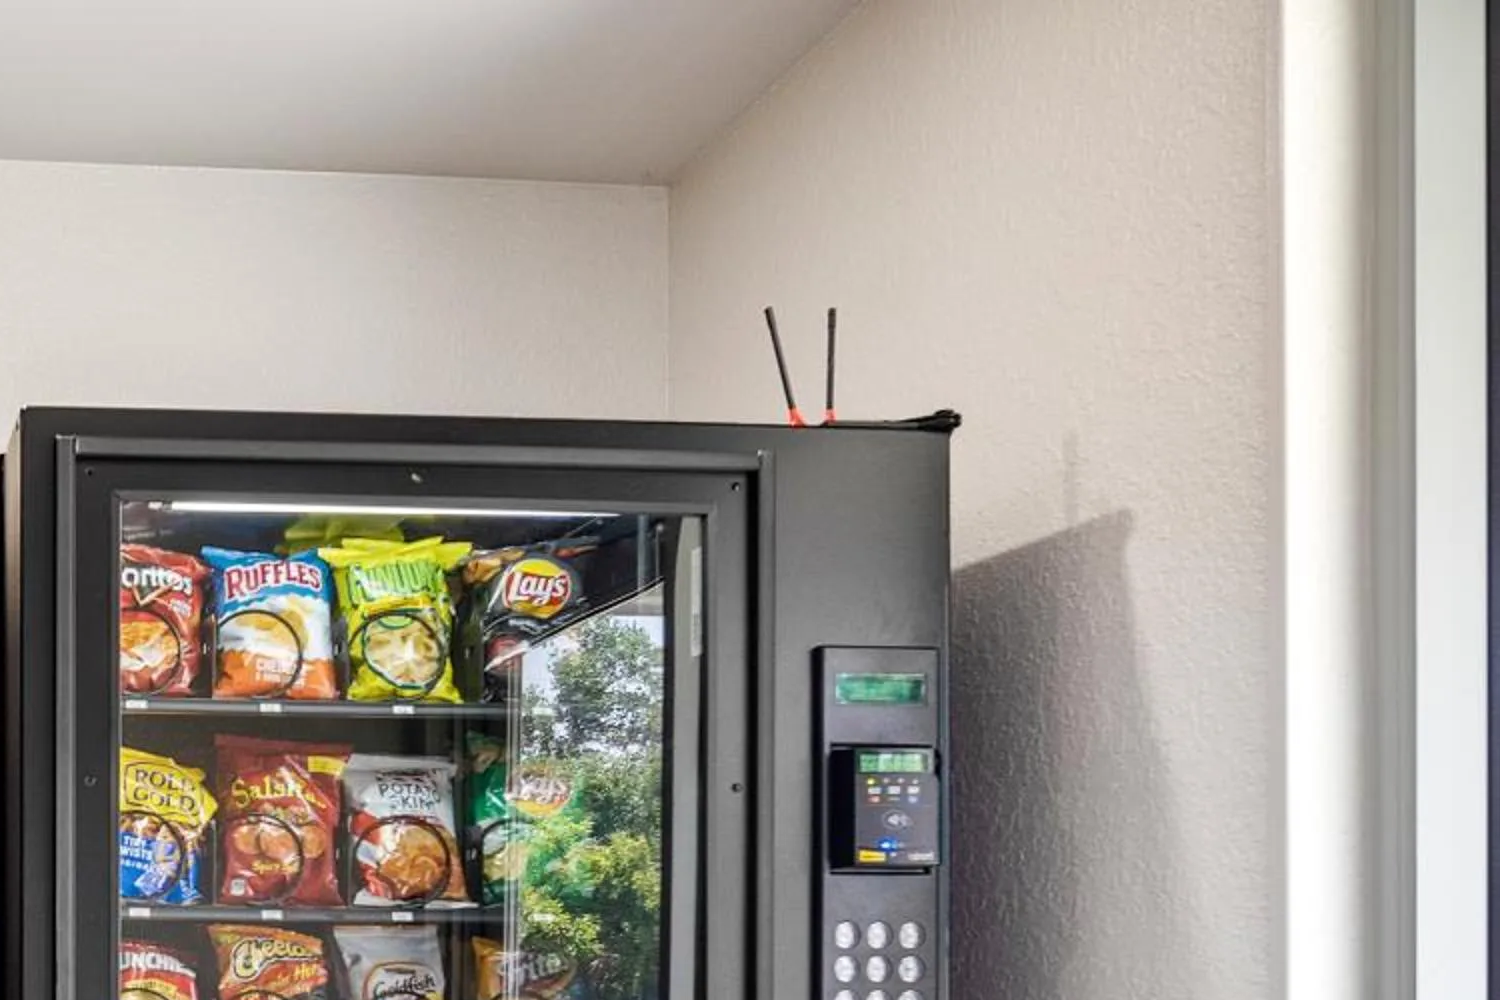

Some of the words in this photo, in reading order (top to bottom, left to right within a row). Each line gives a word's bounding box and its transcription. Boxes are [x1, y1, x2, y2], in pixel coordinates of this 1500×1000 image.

[122, 567, 193, 596] oritos
[225, 559, 322, 599] RUFFLES
[133, 786, 196, 813] GOLD
